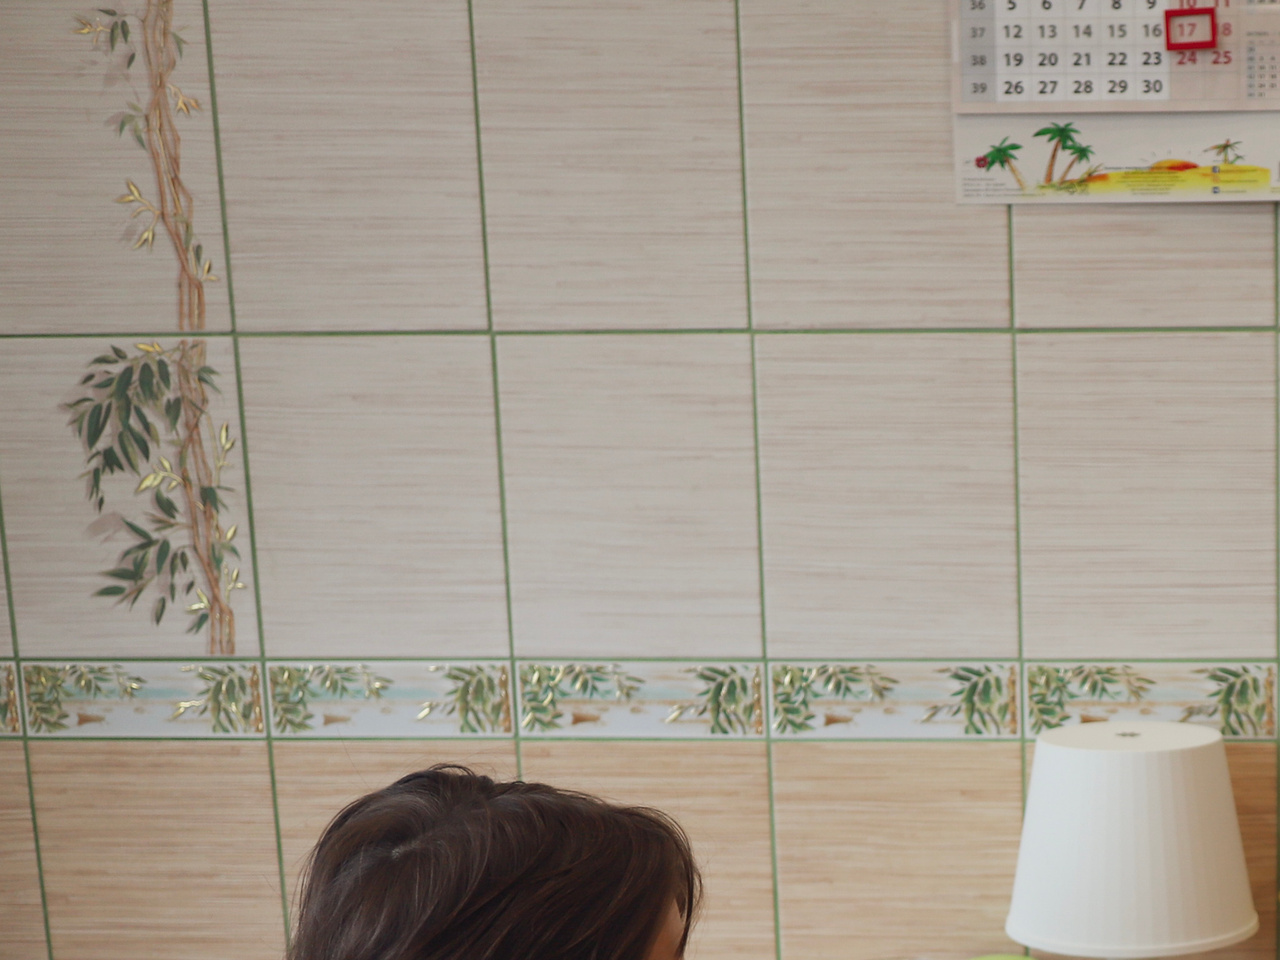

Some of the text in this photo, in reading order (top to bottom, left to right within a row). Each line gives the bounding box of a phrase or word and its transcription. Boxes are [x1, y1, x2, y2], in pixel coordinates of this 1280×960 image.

[1006, 0, 1017, 11] 5
[1041, 0, 1053, 11] 6
[1077, 0, 1087, 10] 7
[1110, 0, 1123, 10] 8
[1145, 0, 1157, 9] 9
[970, 27, 986, 38] 37
[1003, 25, 1023, 39] 12
[1038, 25, 1058, 39] 13
[1073, 25, 1093, 39] 14
[1108, 24, 1127, 38] 15
[1143, 23, 1162, 38] 16
[1178, 23, 1197, 37] 17
[971, 50, 1232, 68] 38 19 20 21 22 23 24 25
[972, 79, 1163, 95] 39 26 27 28 29 30
